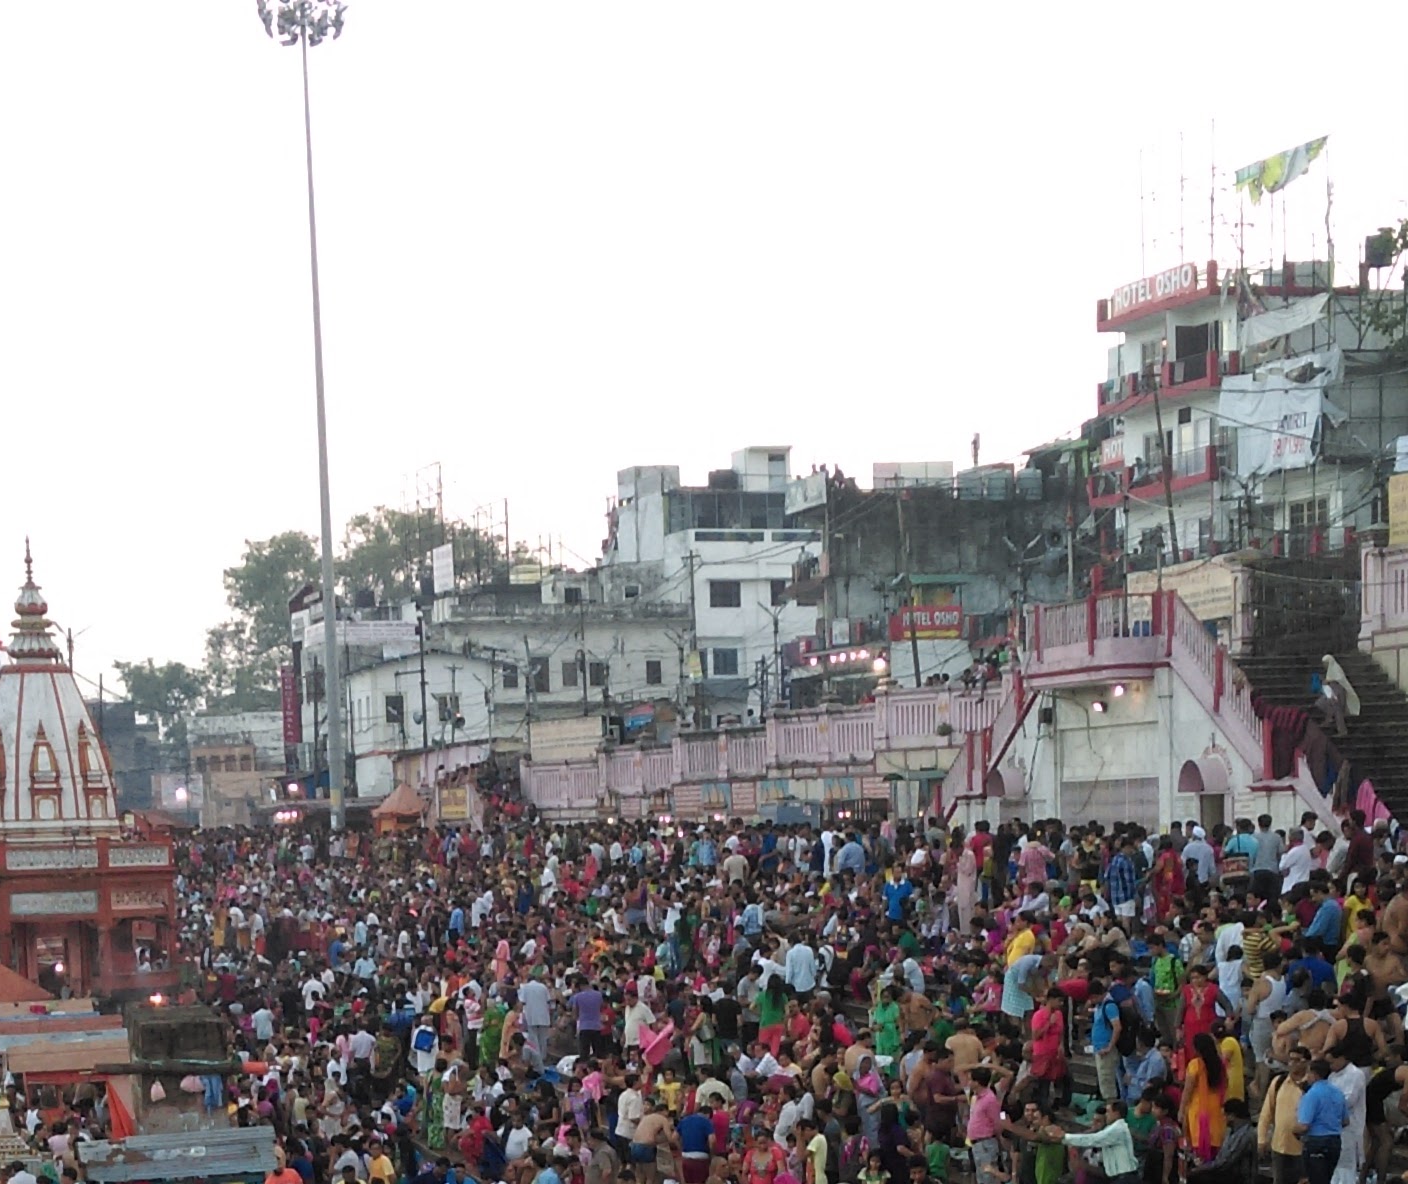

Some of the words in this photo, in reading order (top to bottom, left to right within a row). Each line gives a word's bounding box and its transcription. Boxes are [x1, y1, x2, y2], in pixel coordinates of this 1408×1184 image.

[1114, 278, 1152, 311] HOTEL
[1156, 264, 1193, 297] OSHO
[934, 611, 959, 626] OSHO
